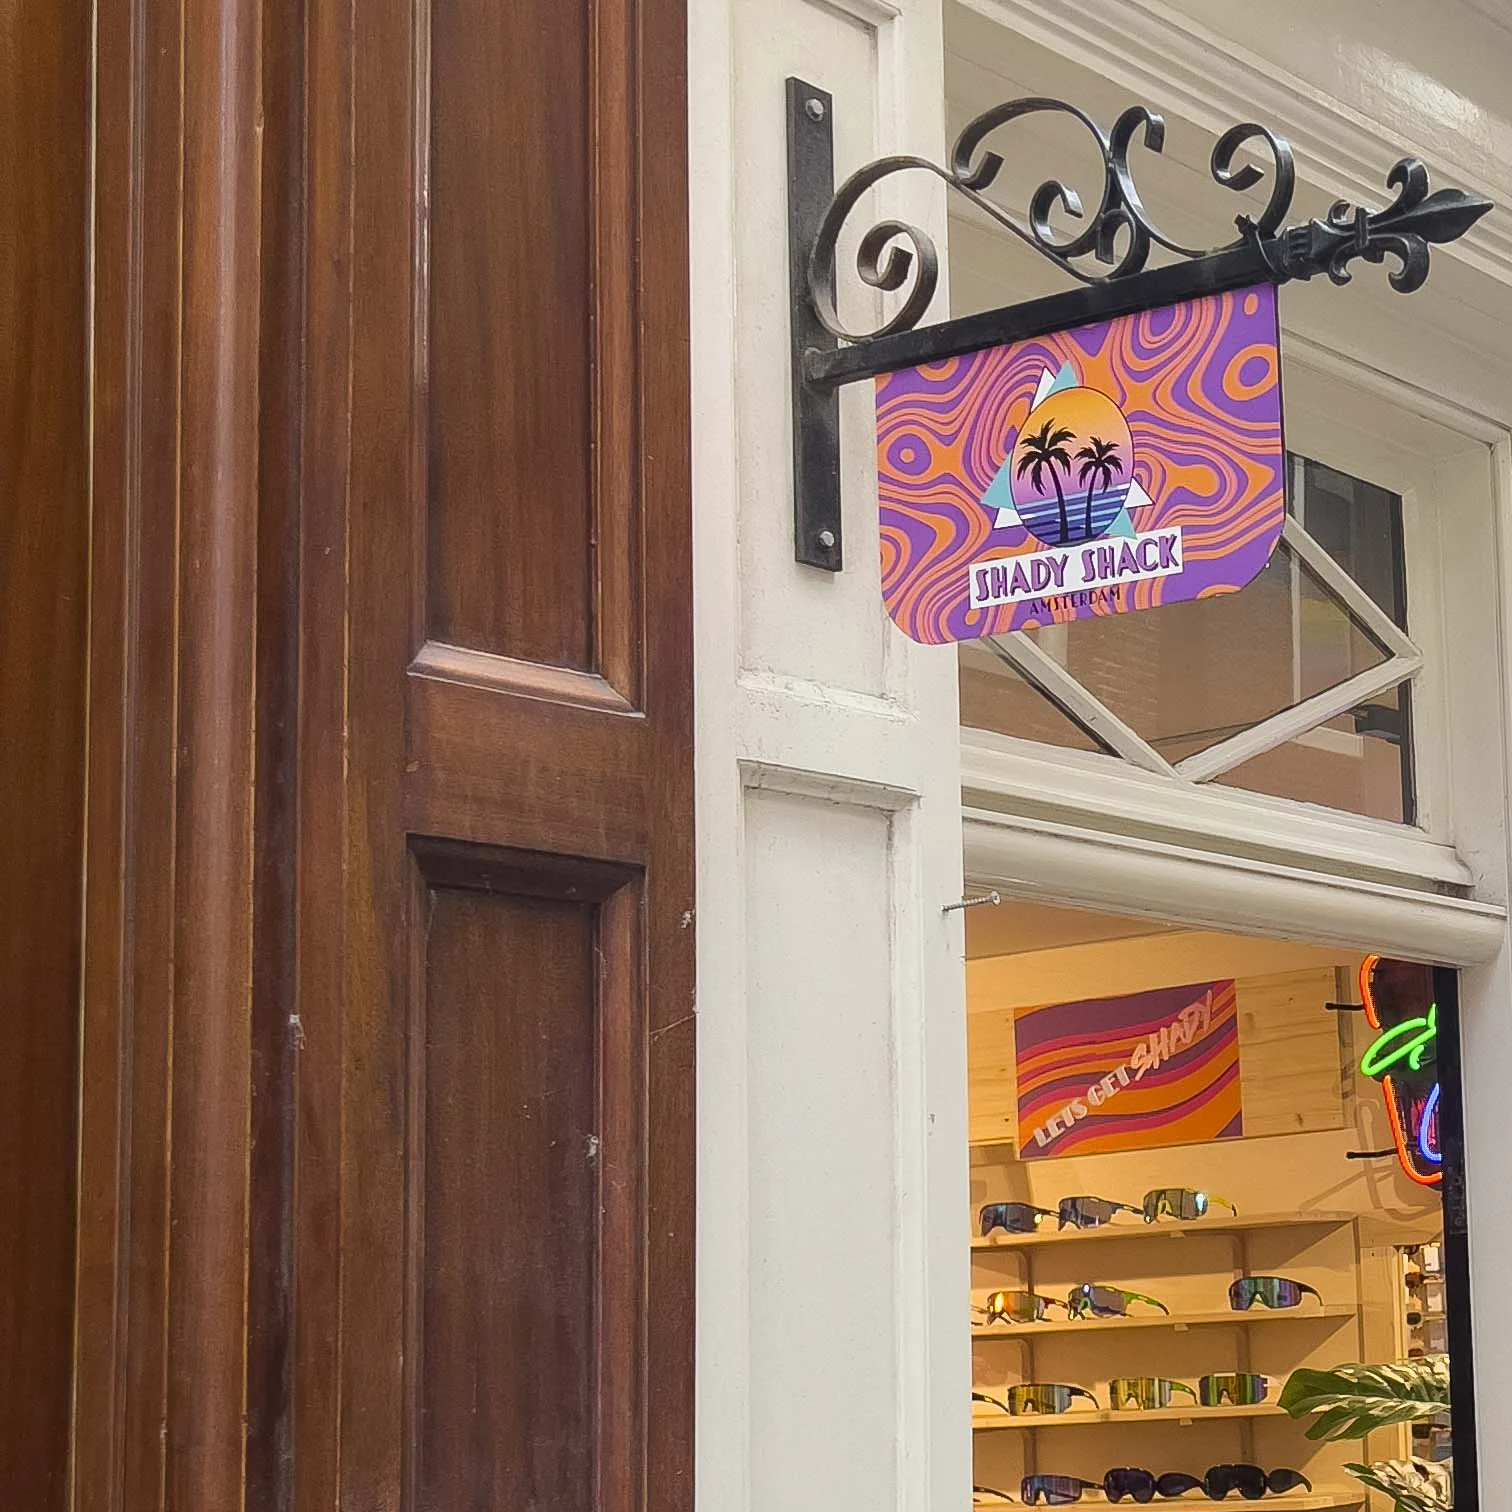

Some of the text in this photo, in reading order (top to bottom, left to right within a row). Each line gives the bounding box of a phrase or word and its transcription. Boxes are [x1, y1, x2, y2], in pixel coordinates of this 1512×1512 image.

[975, 535, 1179, 601] SHADY SHACK
[1029, 587, 1121, 615] AMSTERDAM
[1087, 1064, 1131, 1107] GET
